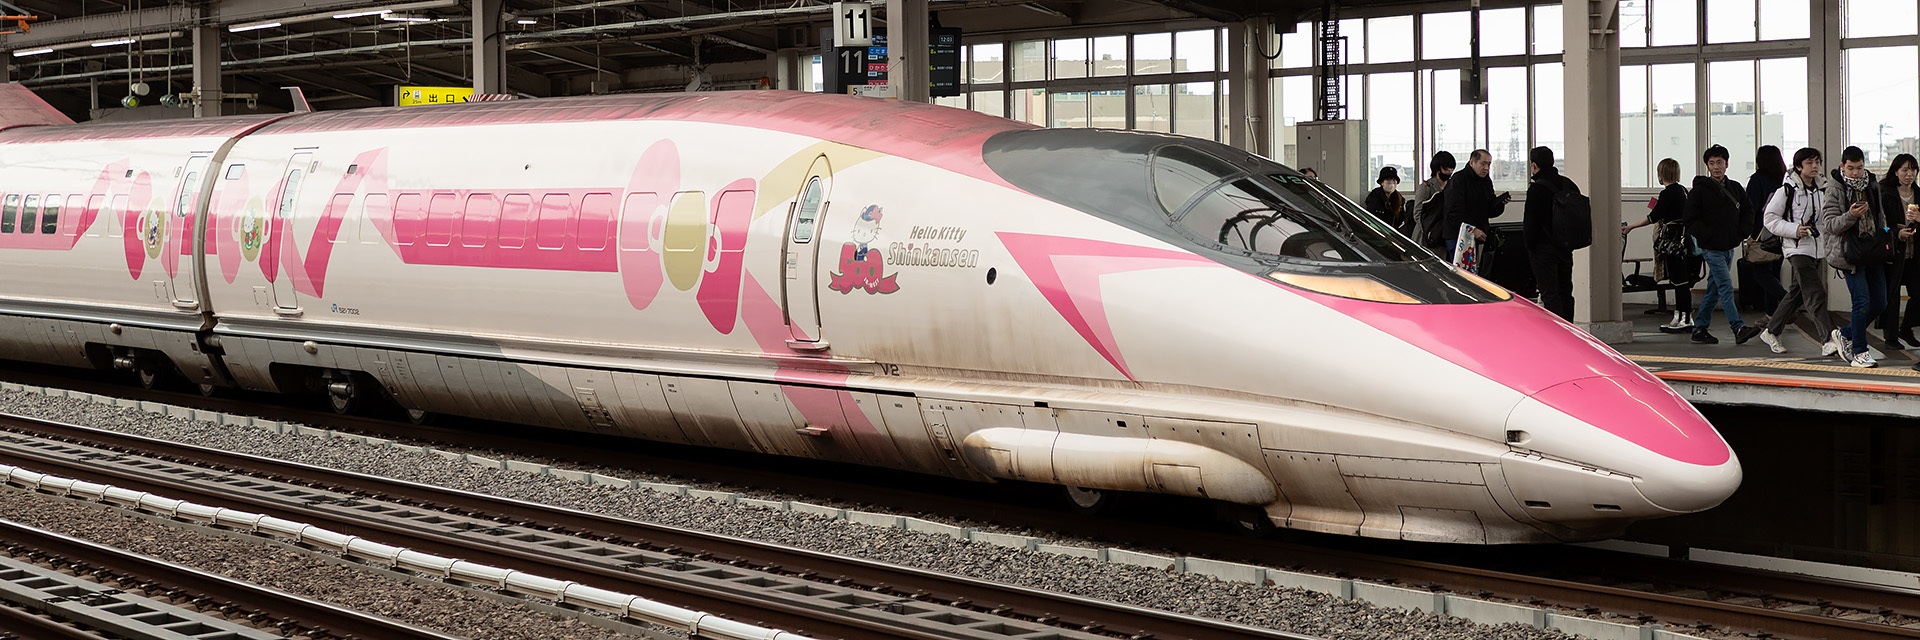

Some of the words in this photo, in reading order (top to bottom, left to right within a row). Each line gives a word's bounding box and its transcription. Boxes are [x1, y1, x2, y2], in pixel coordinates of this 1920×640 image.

[845, 9, 868, 39] 11
[841, 50, 862, 73] 11
[428, 93, 455, 103] 出口
[1270, 175, 1306, 185] V2
[910, 225, 938, 240] Hello
[938, 226, 967, 243] Kitty
[887, 241, 979, 268] Shinkansen
[880, 363, 900, 376] V2
